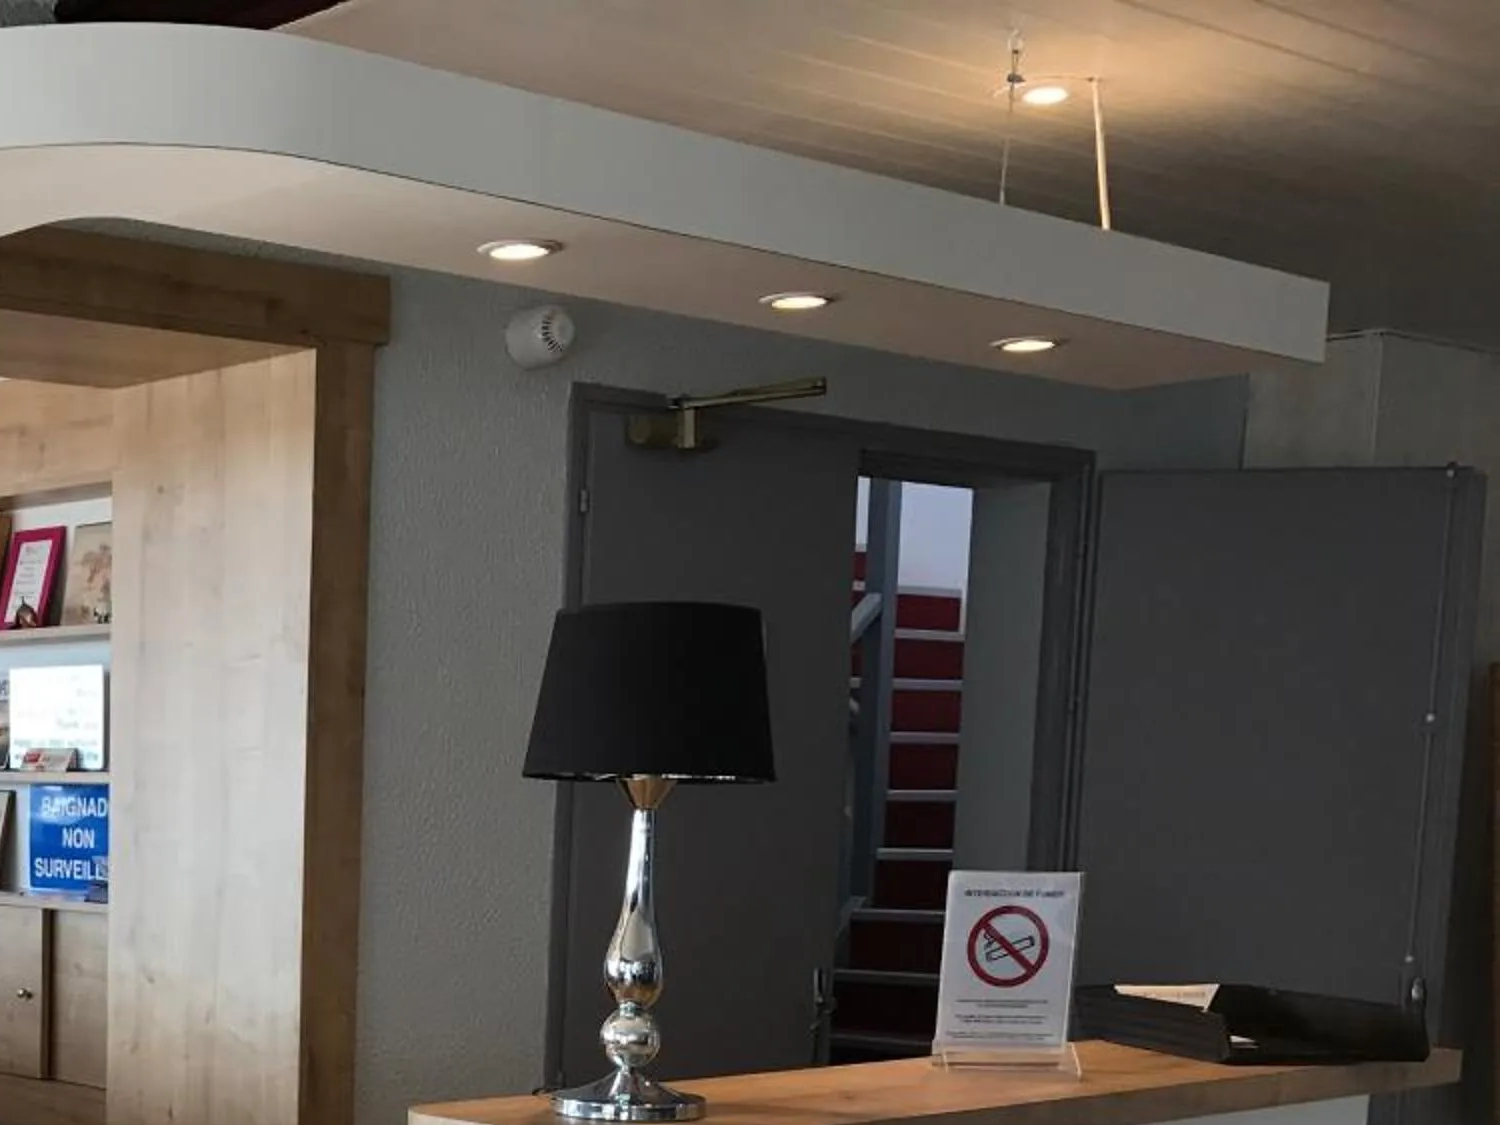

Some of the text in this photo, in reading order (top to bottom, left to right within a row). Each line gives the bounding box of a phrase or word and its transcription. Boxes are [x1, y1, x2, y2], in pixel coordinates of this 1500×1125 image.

[41, 795, 107, 818] BAIGNAD
[61, 827, 95, 849] NON
[35, 857, 108, 881] SURVEILL
